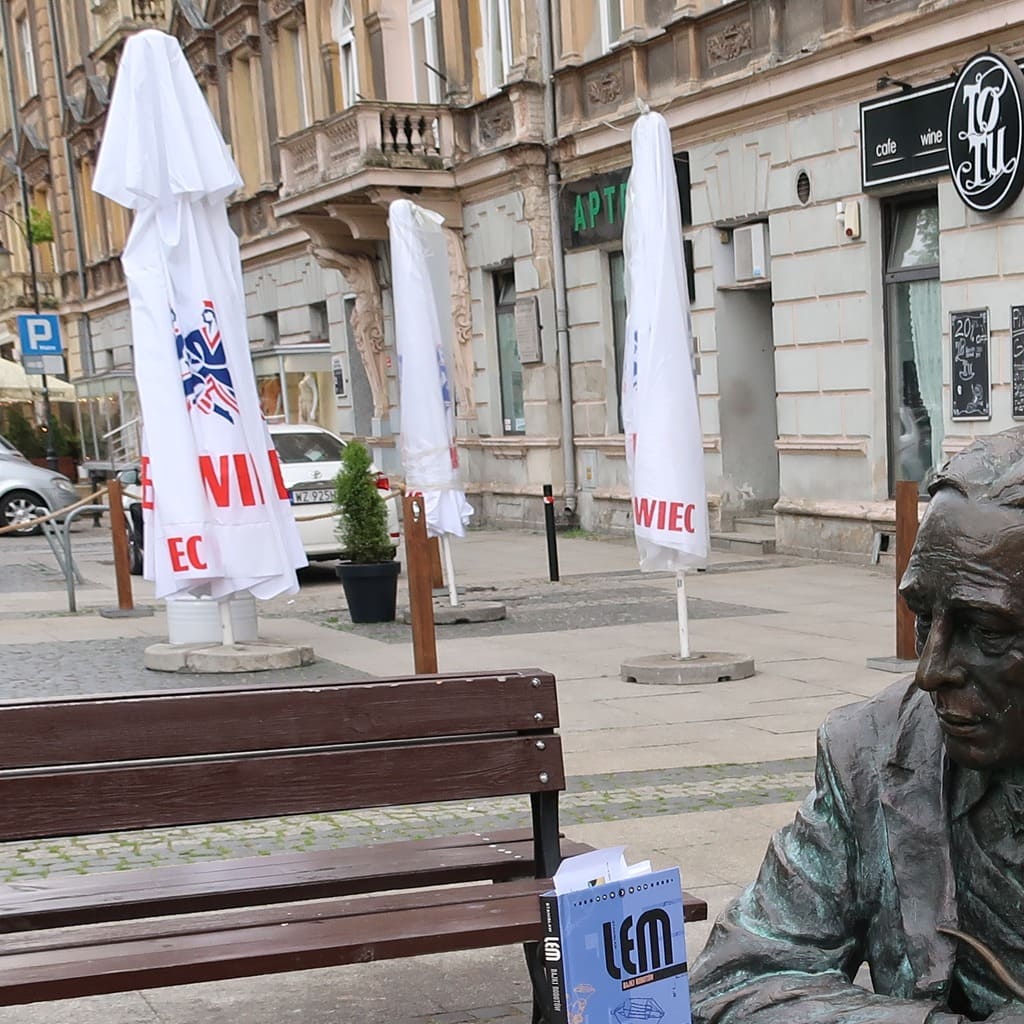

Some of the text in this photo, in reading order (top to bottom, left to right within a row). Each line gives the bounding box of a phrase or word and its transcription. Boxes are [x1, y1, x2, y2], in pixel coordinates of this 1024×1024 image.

[875, 127, 943, 157] cafe wine
[26, 318, 52, 350] P
[167, 535, 208, 573] EC
[544, 936, 562, 961] LEM
[602, 908, 674, 981] LEM
